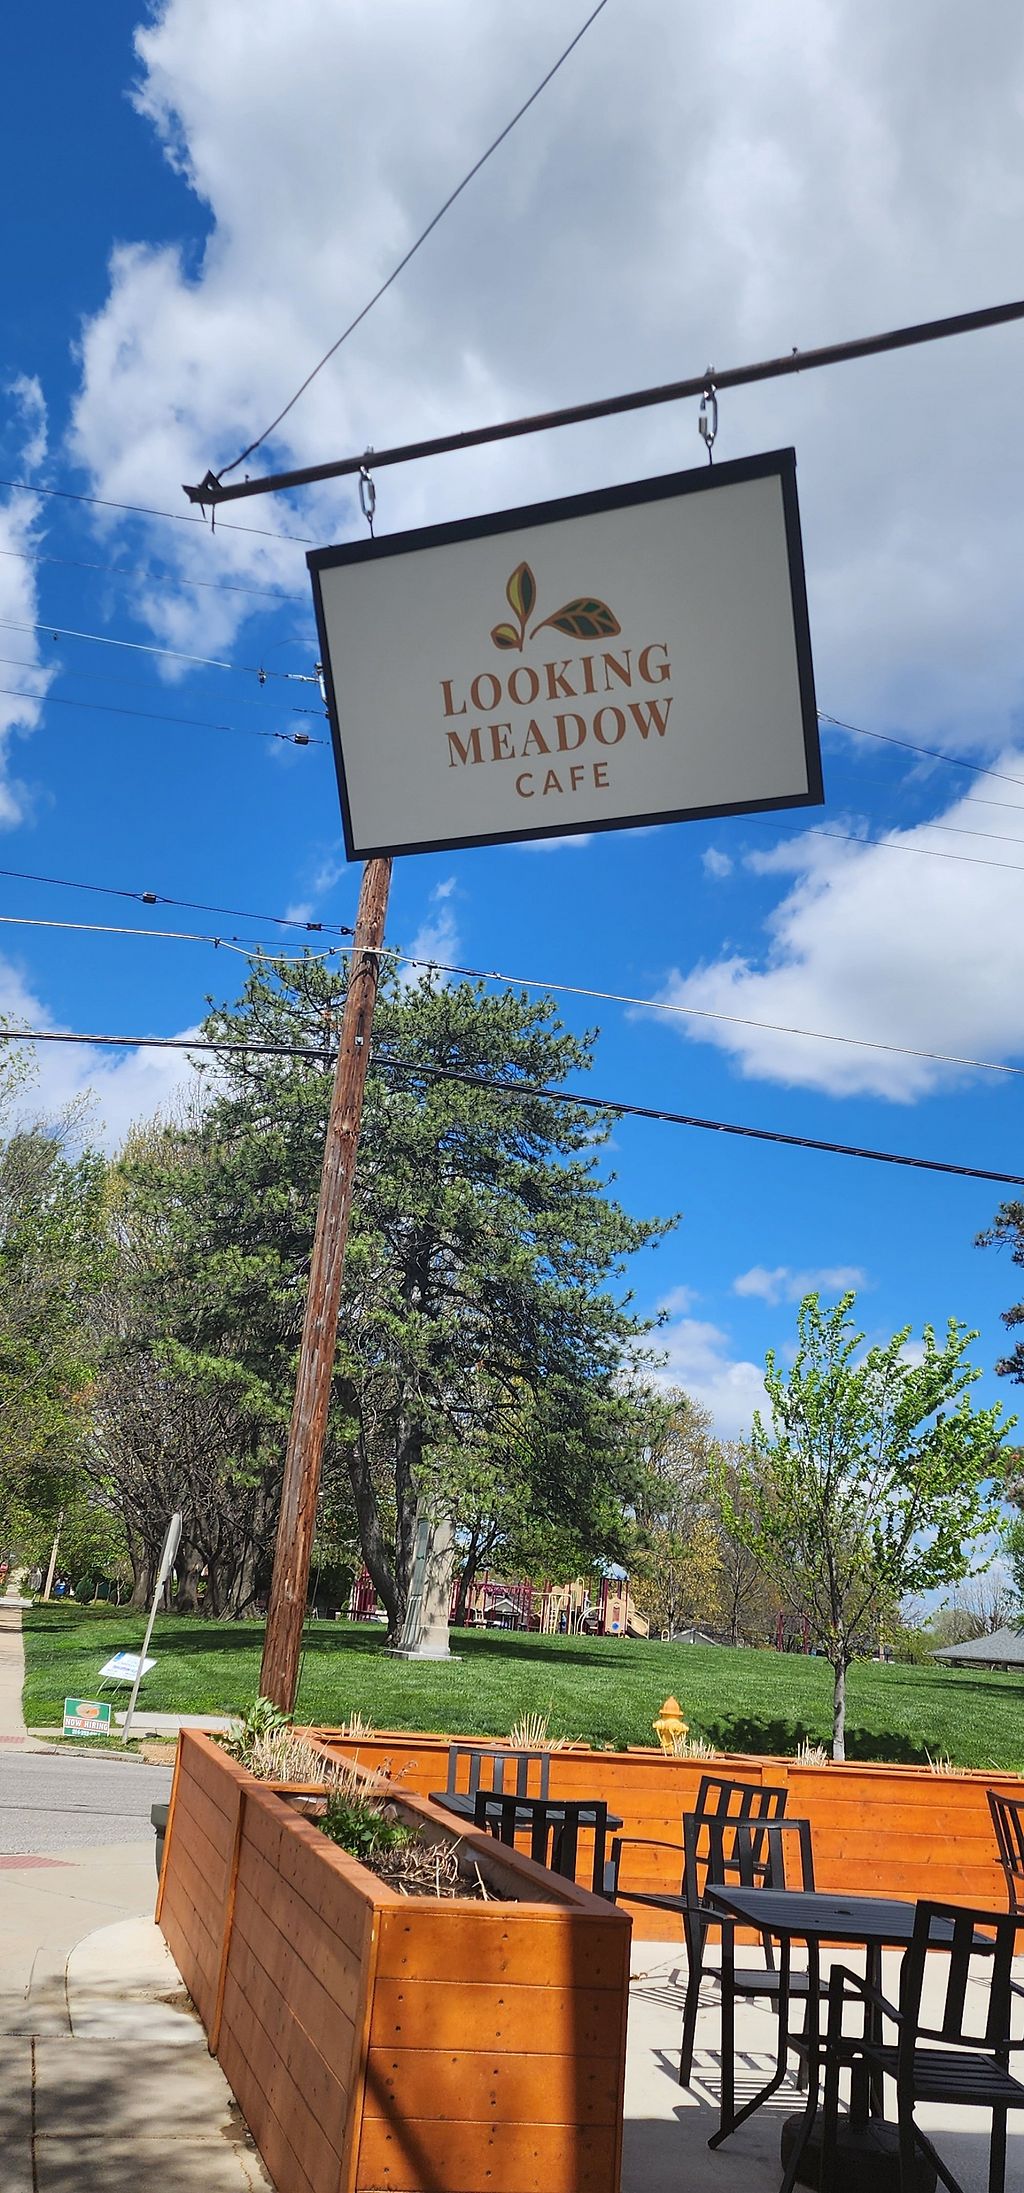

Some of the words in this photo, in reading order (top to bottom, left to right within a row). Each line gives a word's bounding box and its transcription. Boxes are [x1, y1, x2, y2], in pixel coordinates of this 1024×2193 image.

[439, 643, 671, 717] LOOKING
[445, 697, 673, 767] MEADOW
[515, 762, 609, 798] CAFE
[65, 1718, 81, 1727] NOW
[84, 1720, 108, 1731] HIRING
